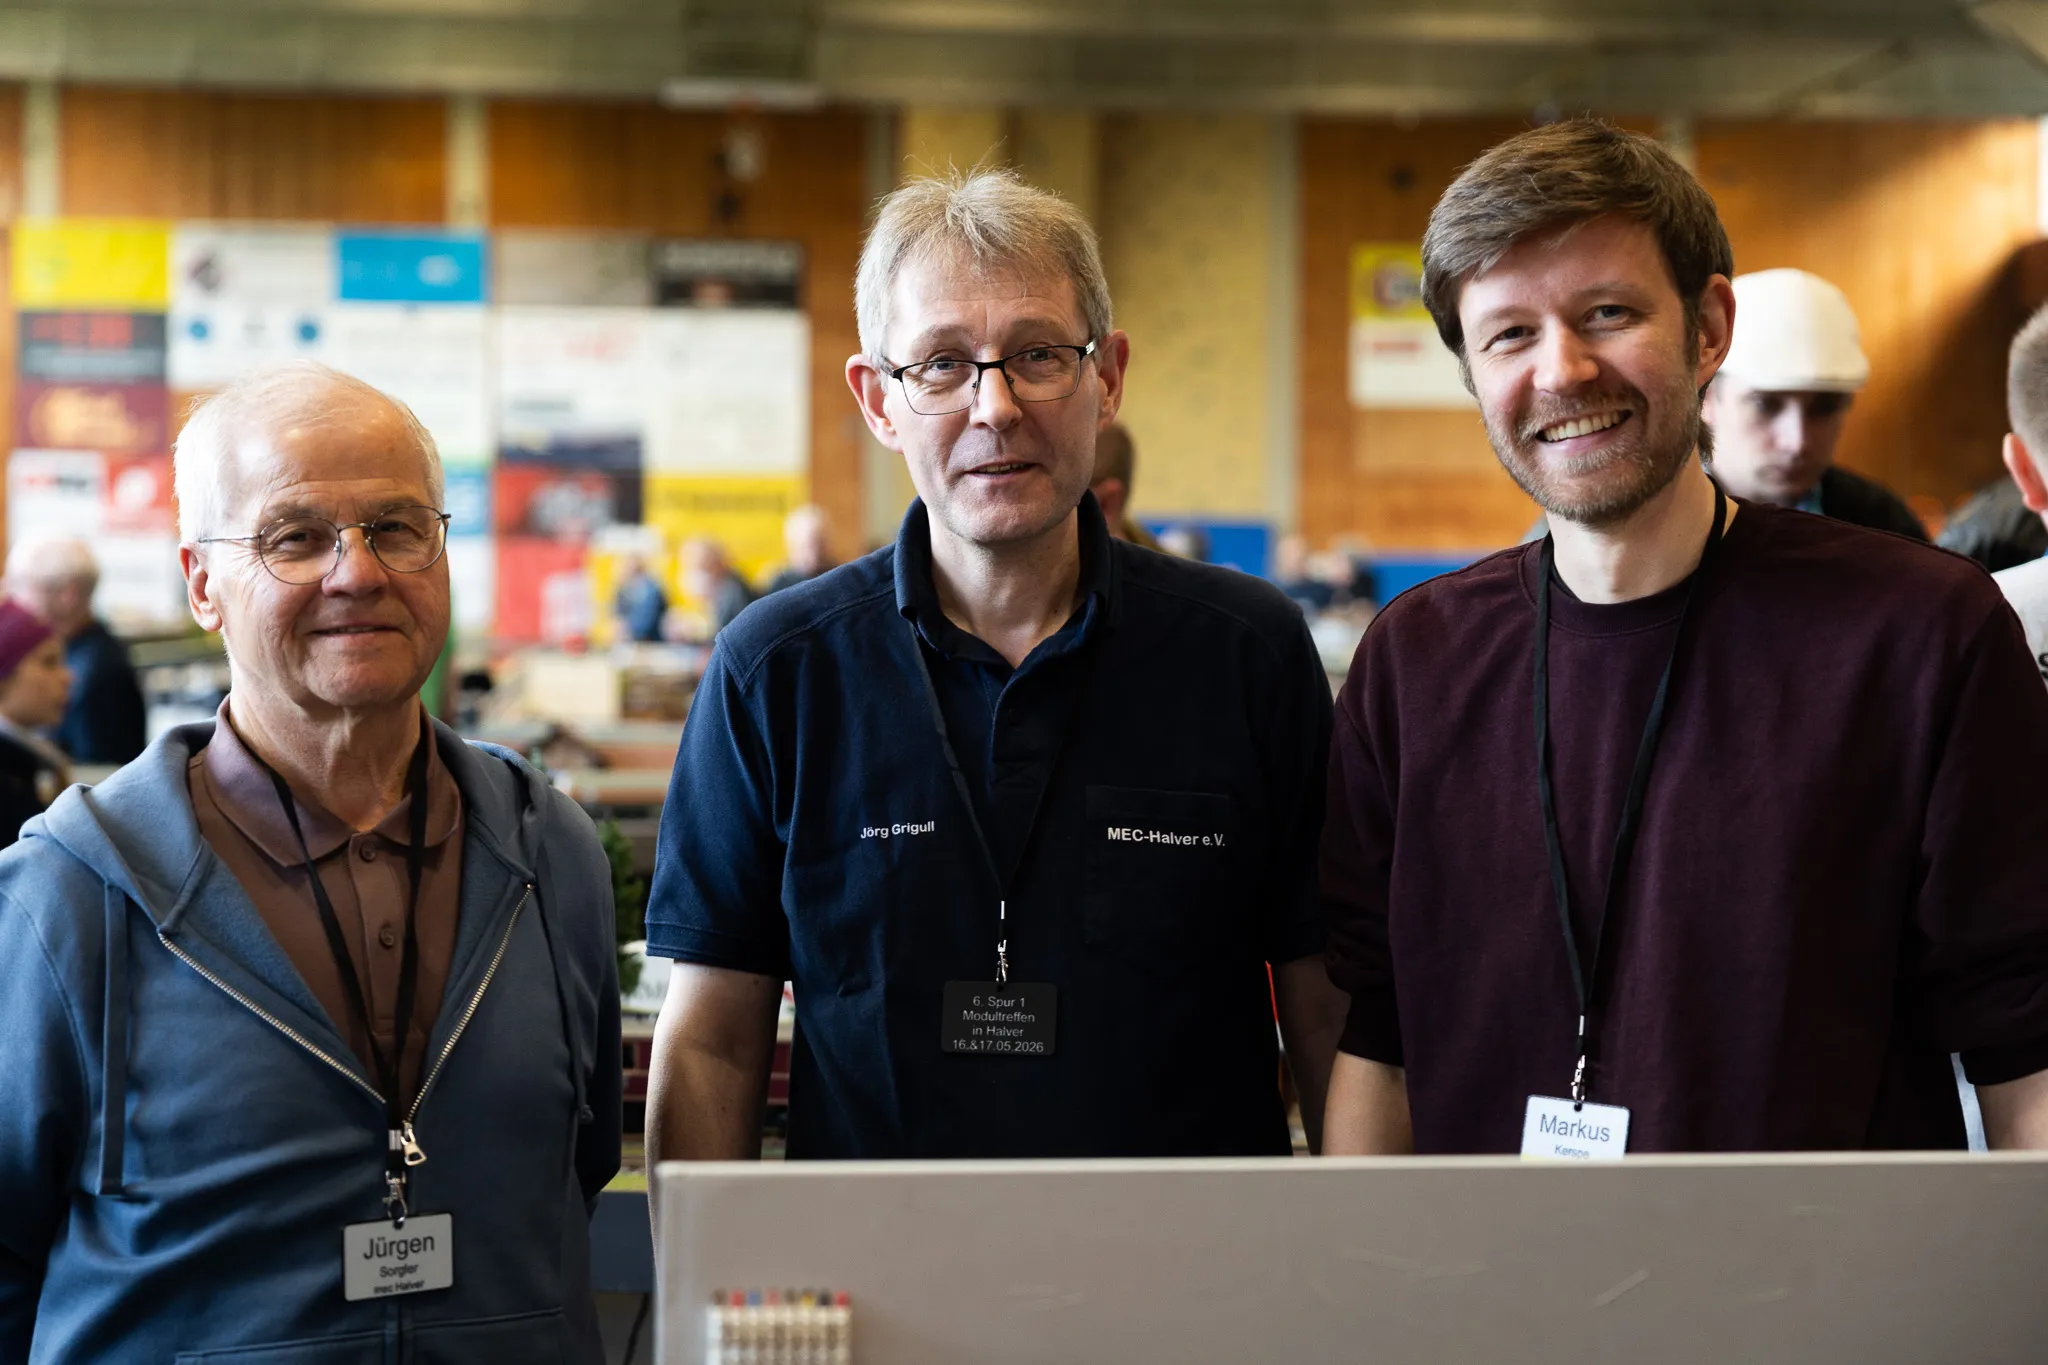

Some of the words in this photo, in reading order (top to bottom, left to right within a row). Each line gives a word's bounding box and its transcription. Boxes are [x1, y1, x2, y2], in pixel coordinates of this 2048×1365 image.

[860, 826, 889, 839] Jörg
[891, 820, 935, 835] Grigull
[1108, 827, 1199, 845] MEC-Halver
[1201, 833, 1226, 847] e.V.
[973, 996, 985, 1007] 6.
[987, 996, 1016, 1008] Spur
[1019, 997, 1026, 1008] 1
[963, 1010, 1036, 1022] Modultreffen
[972, 1024, 983, 1036] in
[986, 1025, 1024, 1038] Halver
[952, 1039, 1044, 1053] 16.&17.05.2026
[1540, 1113, 1610, 1142] Markus
[363, 1235, 435, 1260] Jürgen
[379, 1263, 419, 1279] Sorgler
[395, 1280, 425, 1291] Halver
